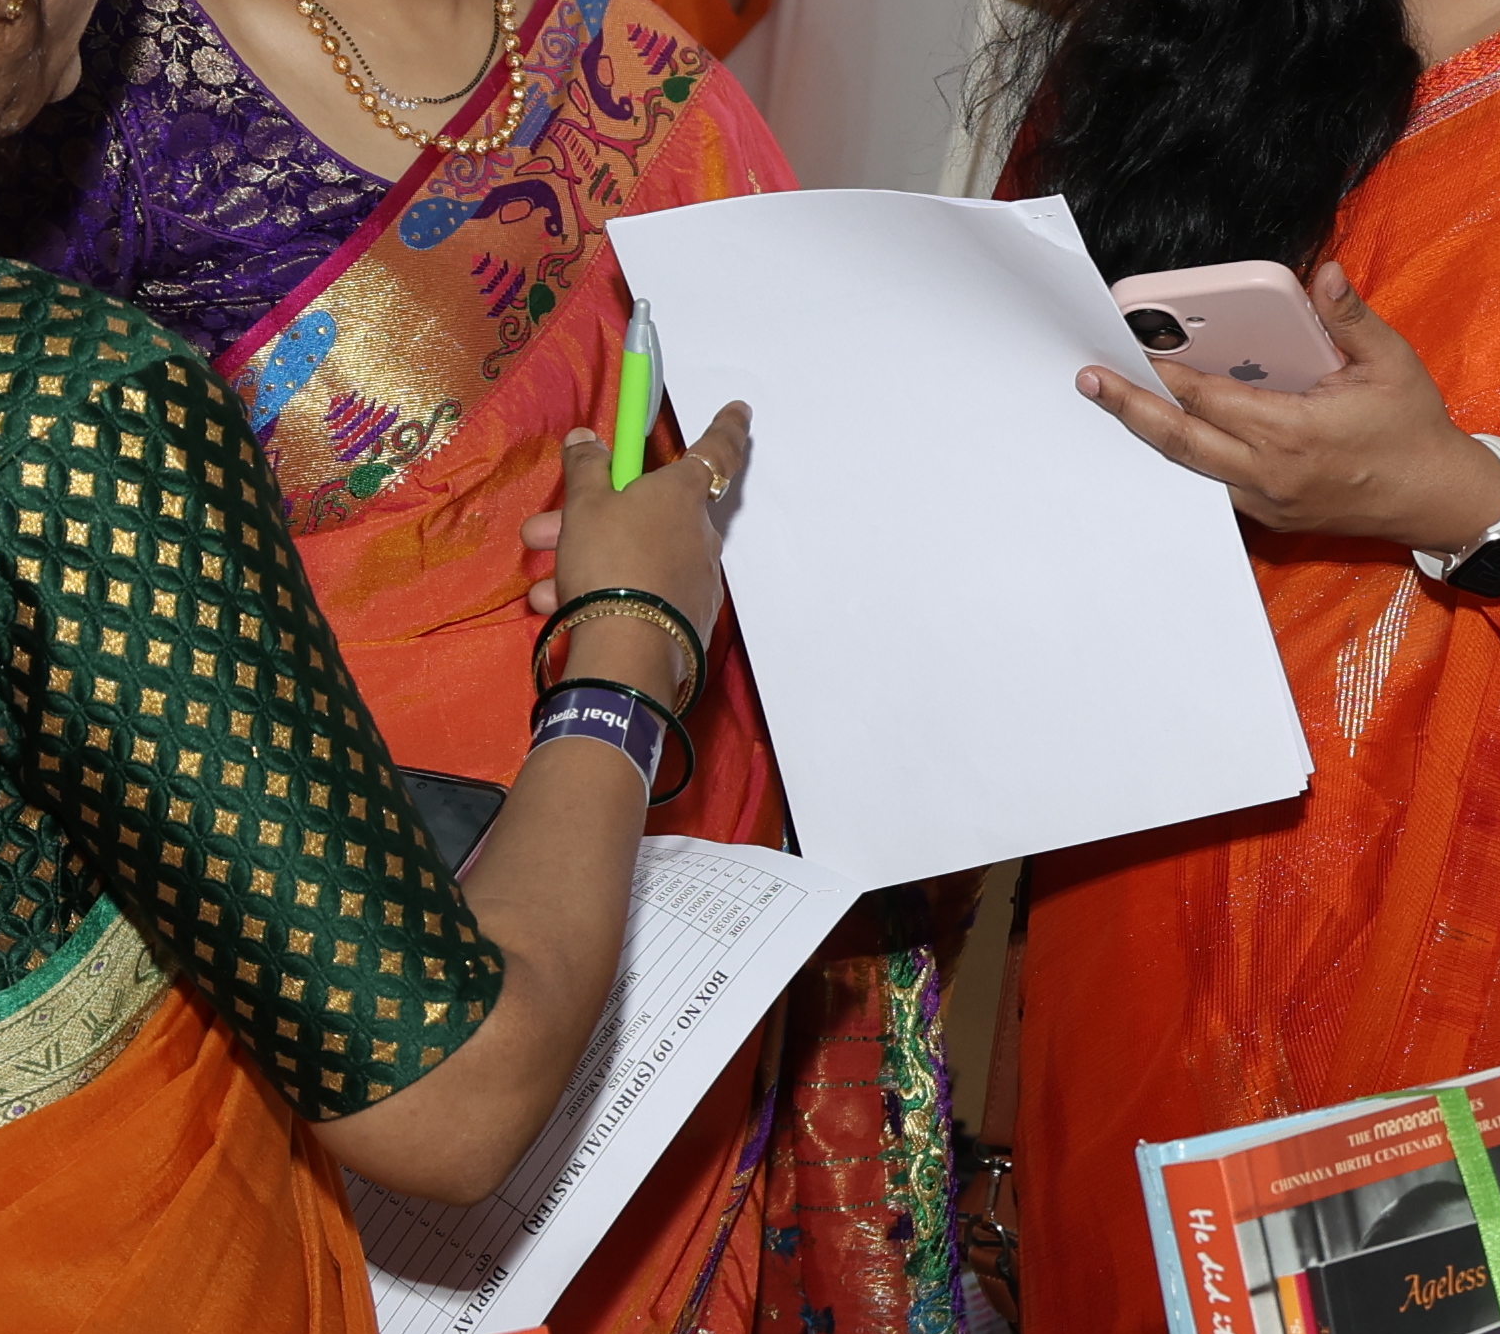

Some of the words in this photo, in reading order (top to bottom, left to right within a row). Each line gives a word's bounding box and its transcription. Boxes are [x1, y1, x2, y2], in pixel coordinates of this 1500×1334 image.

[669, 882, 699, 910] K0009
[682, 888, 714, 919] W0001
[697, 896, 727, 926] T0051
[711, 903, 742, 935] M0038
[727, 915, 751, 939] CODE
[695, 968, 730, 1004] BOX
[612, 1010, 652, 1057] Musings
[676, 1004, 702, 1031] NO
[651, 1037, 676, 1065] 09
[606, 1057, 636, 1092] TITLES
[565, 1079, 600, 1120] Master
[579, 1059, 658, 1159] (SPIRITUAL
[1347, 1131, 1372, 1149] THE
[1372, 1106, 1444, 1142] mananam
[1270, 1166, 1334, 1196] CHINMAYA
[1335, 1154, 1373, 1176] BIRTH
[1374, 1132, 1444, 1164] CENTENARY
[521, 1160, 587, 1236] MASTER)
[1188, 1207, 1217, 1244] He
[475, 1252, 492, 1276] QTY
[1197, 1248, 1231, 1306] did
[1399, 1262, 1487, 1314] Ageless
